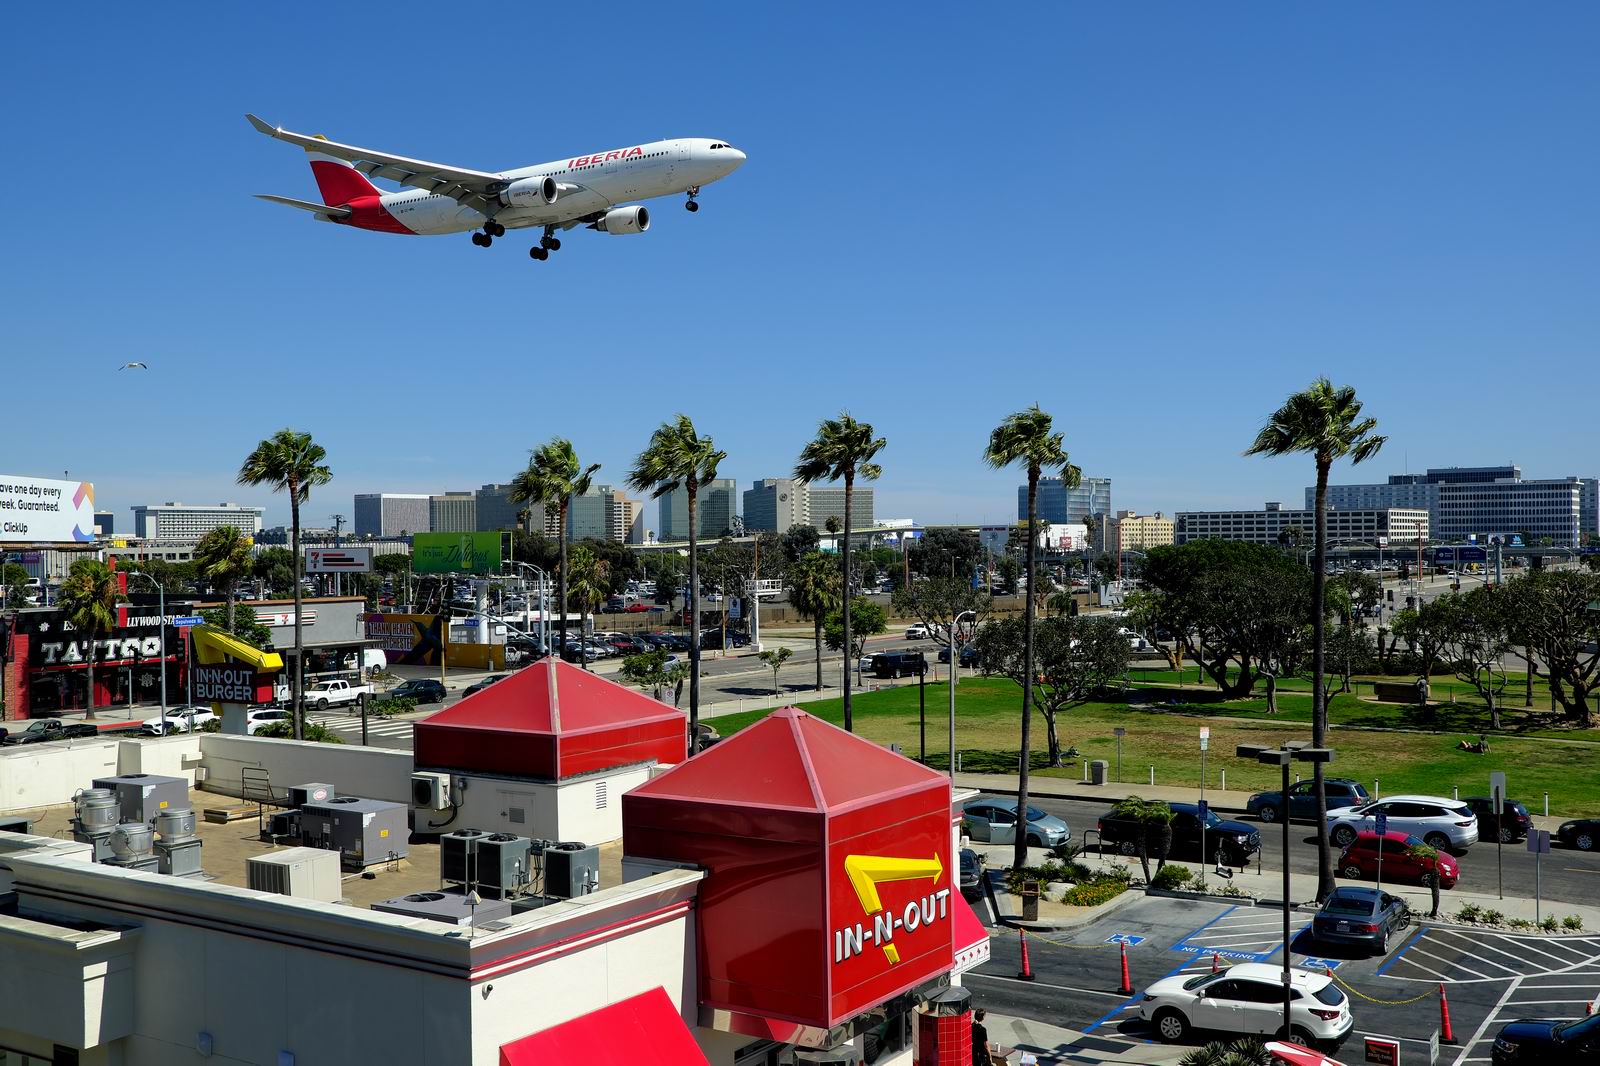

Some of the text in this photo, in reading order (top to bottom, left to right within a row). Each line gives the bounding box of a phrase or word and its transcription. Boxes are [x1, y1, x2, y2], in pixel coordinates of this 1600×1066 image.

[568, 147, 642, 168] IBERIA
[0, 484, 61, 499] ave one day every
[18, 499, 60, 512] Guaranteed.
[4, 522, 28, 535] ClickUp
[127, 616, 162, 627] LLYWOOD
[369, 622, 391, 636] THANK
[391, 622, 414, 637] HEAVEN
[41, 636, 161, 664] TATTOO
[197, 683, 252, 701] BURGER
[835, 889, 950, 963] IN-N-OUT
[1202, 949, 1256, 960] PARKING
